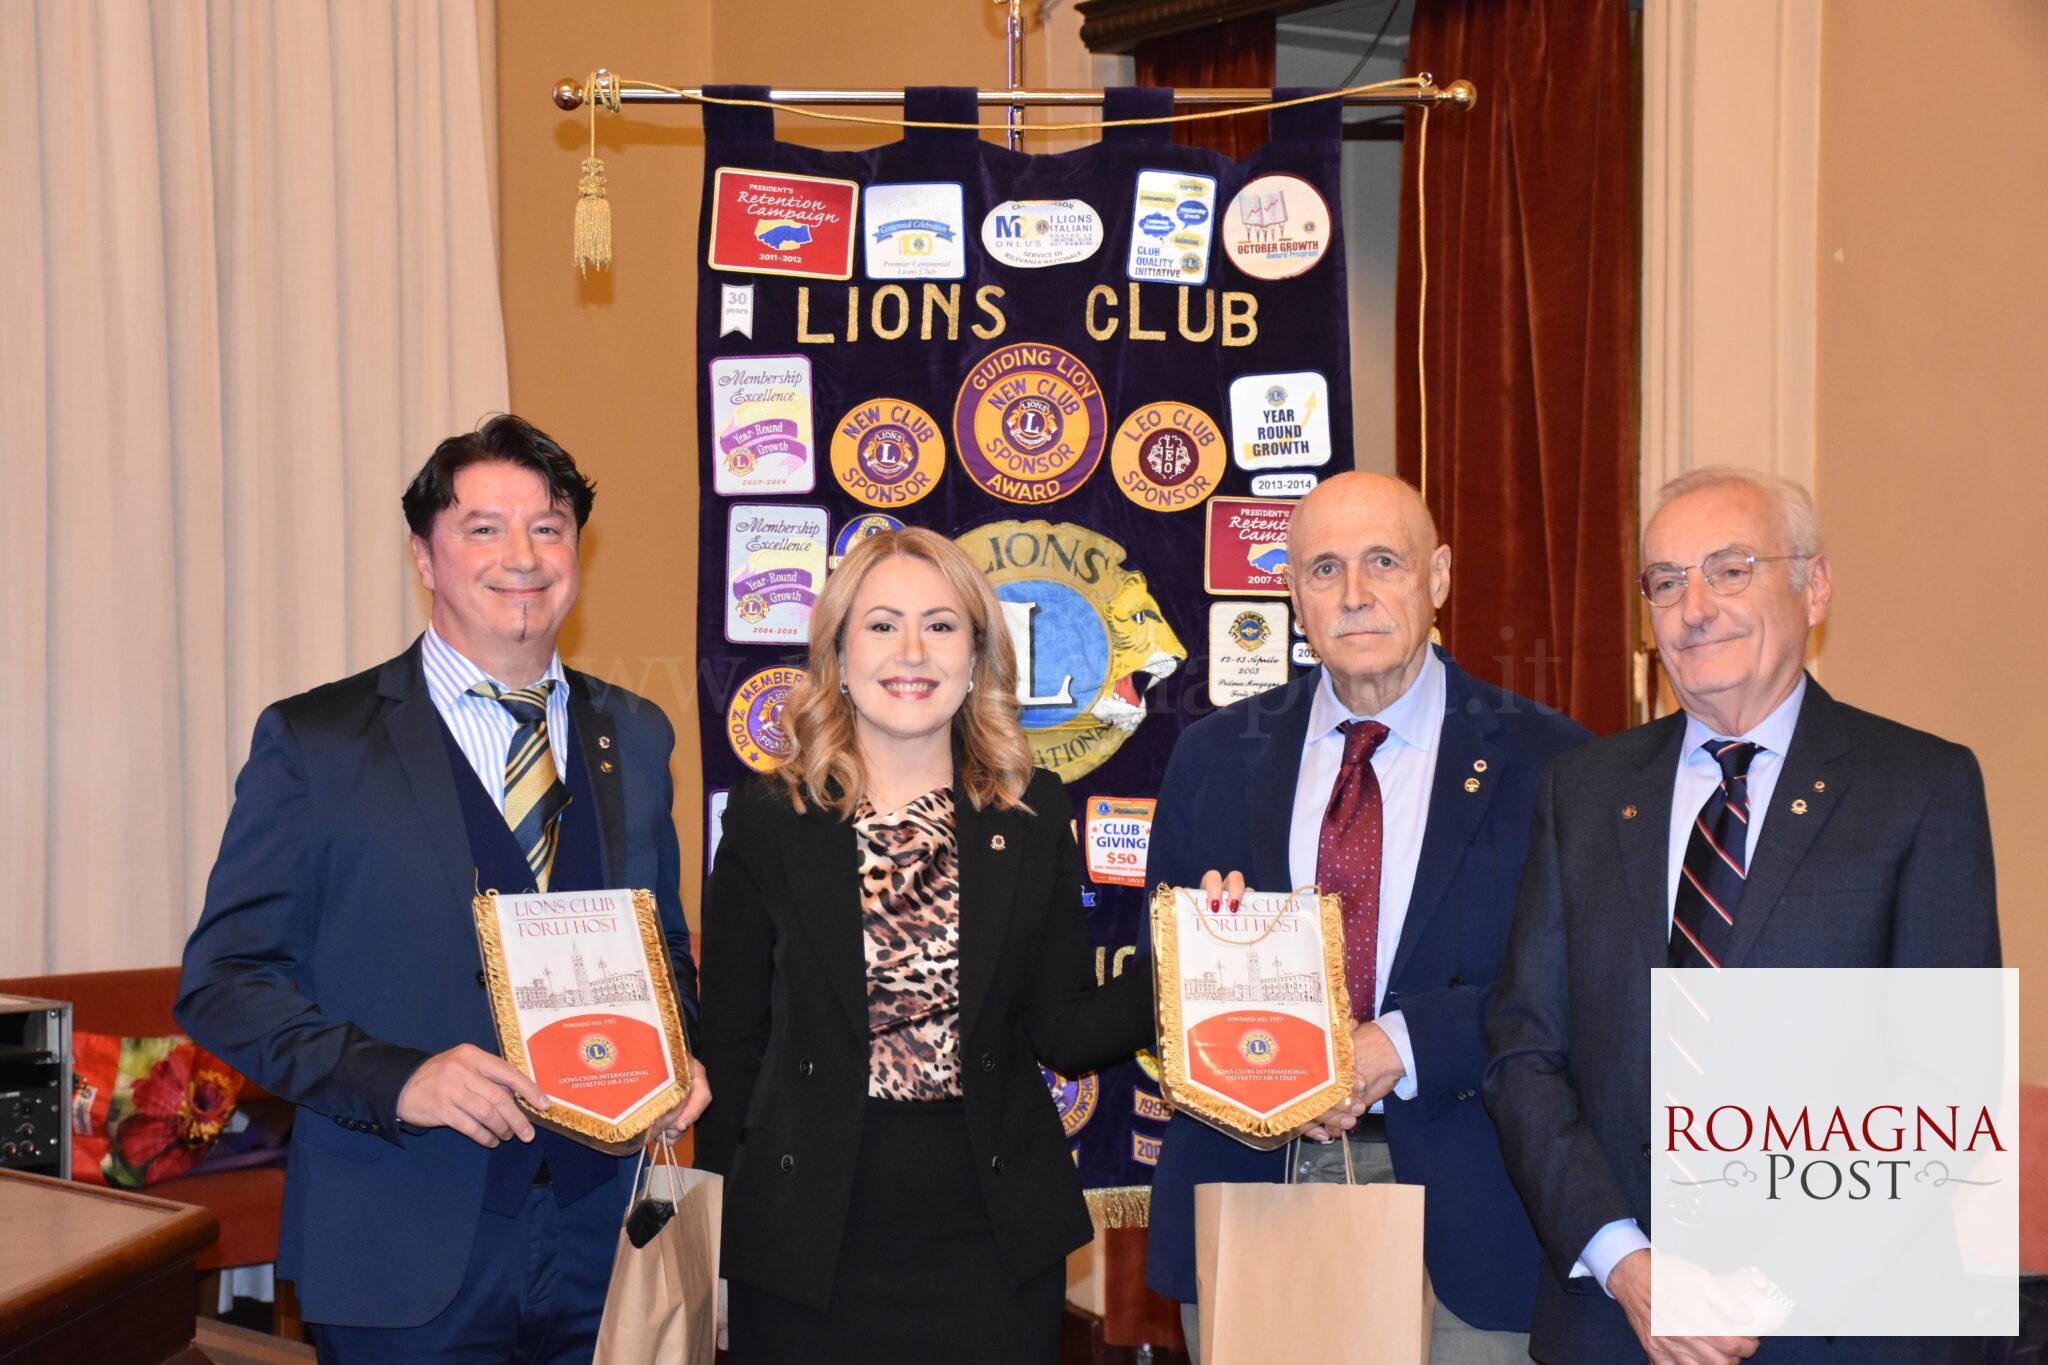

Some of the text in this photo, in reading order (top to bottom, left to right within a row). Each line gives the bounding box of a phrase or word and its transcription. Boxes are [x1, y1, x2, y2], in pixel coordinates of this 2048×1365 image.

[749, 183, 794, 194] PRESIDENT'S
[737, 191, 827, 211] Retention
[747, 204, 840, 228] Campaign
[1057, 215, 1093, 223] LIONS
[880, 220, 948, 233] Centennial Celebration
[996, 240, 1042, 248] ONLUS
[1137, 246, 1160, 256] CLUB
[1237, 241, 1319, 254] OCTOBER GROWTH
[759, 253, 802, 264] 2011-2012
[1136, 257, 1174, 268] QUALITY
[1135, 267, 1182, 278] INITIATIVE
[728, 292, 748, 305] 30
[797, 282, 1259, 347] LIONS CLUB
[718, 369, 803, 387] Membership
[972, 348, 1098, 399] GUIDING LION
[730, 388, 795, 405] Excellence
[987, 377, 1081, 416] NEW CLUB
[1021, 401, 1048, 412] LIONS
[842, 405, 935, 443] NEW CLUB
[1024, 412, 1040, 433] L
[1263, 409, 1295, 424] YEAR
[755, 421, 783, 436] Round
[1123, 409, 1216, 447] LEO CLUB
[1257, 424, 1302, 441] ROUND
[877, 431, 903, 441] LIONS
[757, 441, 788, 455] Growth
[880, 443, 896, 463] L
[1252, 440, 1310, 457] GROWTH
[986, 437, 1076, 475] SPONSOR
[842, 467, 932, 503] SPONSOR
[986, 473, 1061, 501] AWARD
[1122, 470, 1211, 506] SPONSOR
[1258, 479, 1312, 490] 2013-2014
[1240, 508, 1290, 518] PRESIDENT'S
[735, 517, 820, 537] Membership
[1228, 516, 1289, 531] Retent
[1239, 528, 1288, 543] Camp
[746, 535, 812, 552] Excellence
[984, 532, 1111, 585] IONS
[746, 571, 798, 591] Year Round
[770, 590, 802, 603] Growth
[1238, 667, 1260, 675] 2003
[1103, 823, 1140, 835] CLUB
[1096, 836, 1147, 849] GIVING
[1107, 852, 1137, 864] $50
[514, 897, 616, 916] LIONS CLUB
[1253, 898, 1300, 912] CLUB
[574, 917, 619, 935] HOST
[1254, 918, 1300, 932] HOST
[559, 1075, 578, 1084] LIONS
